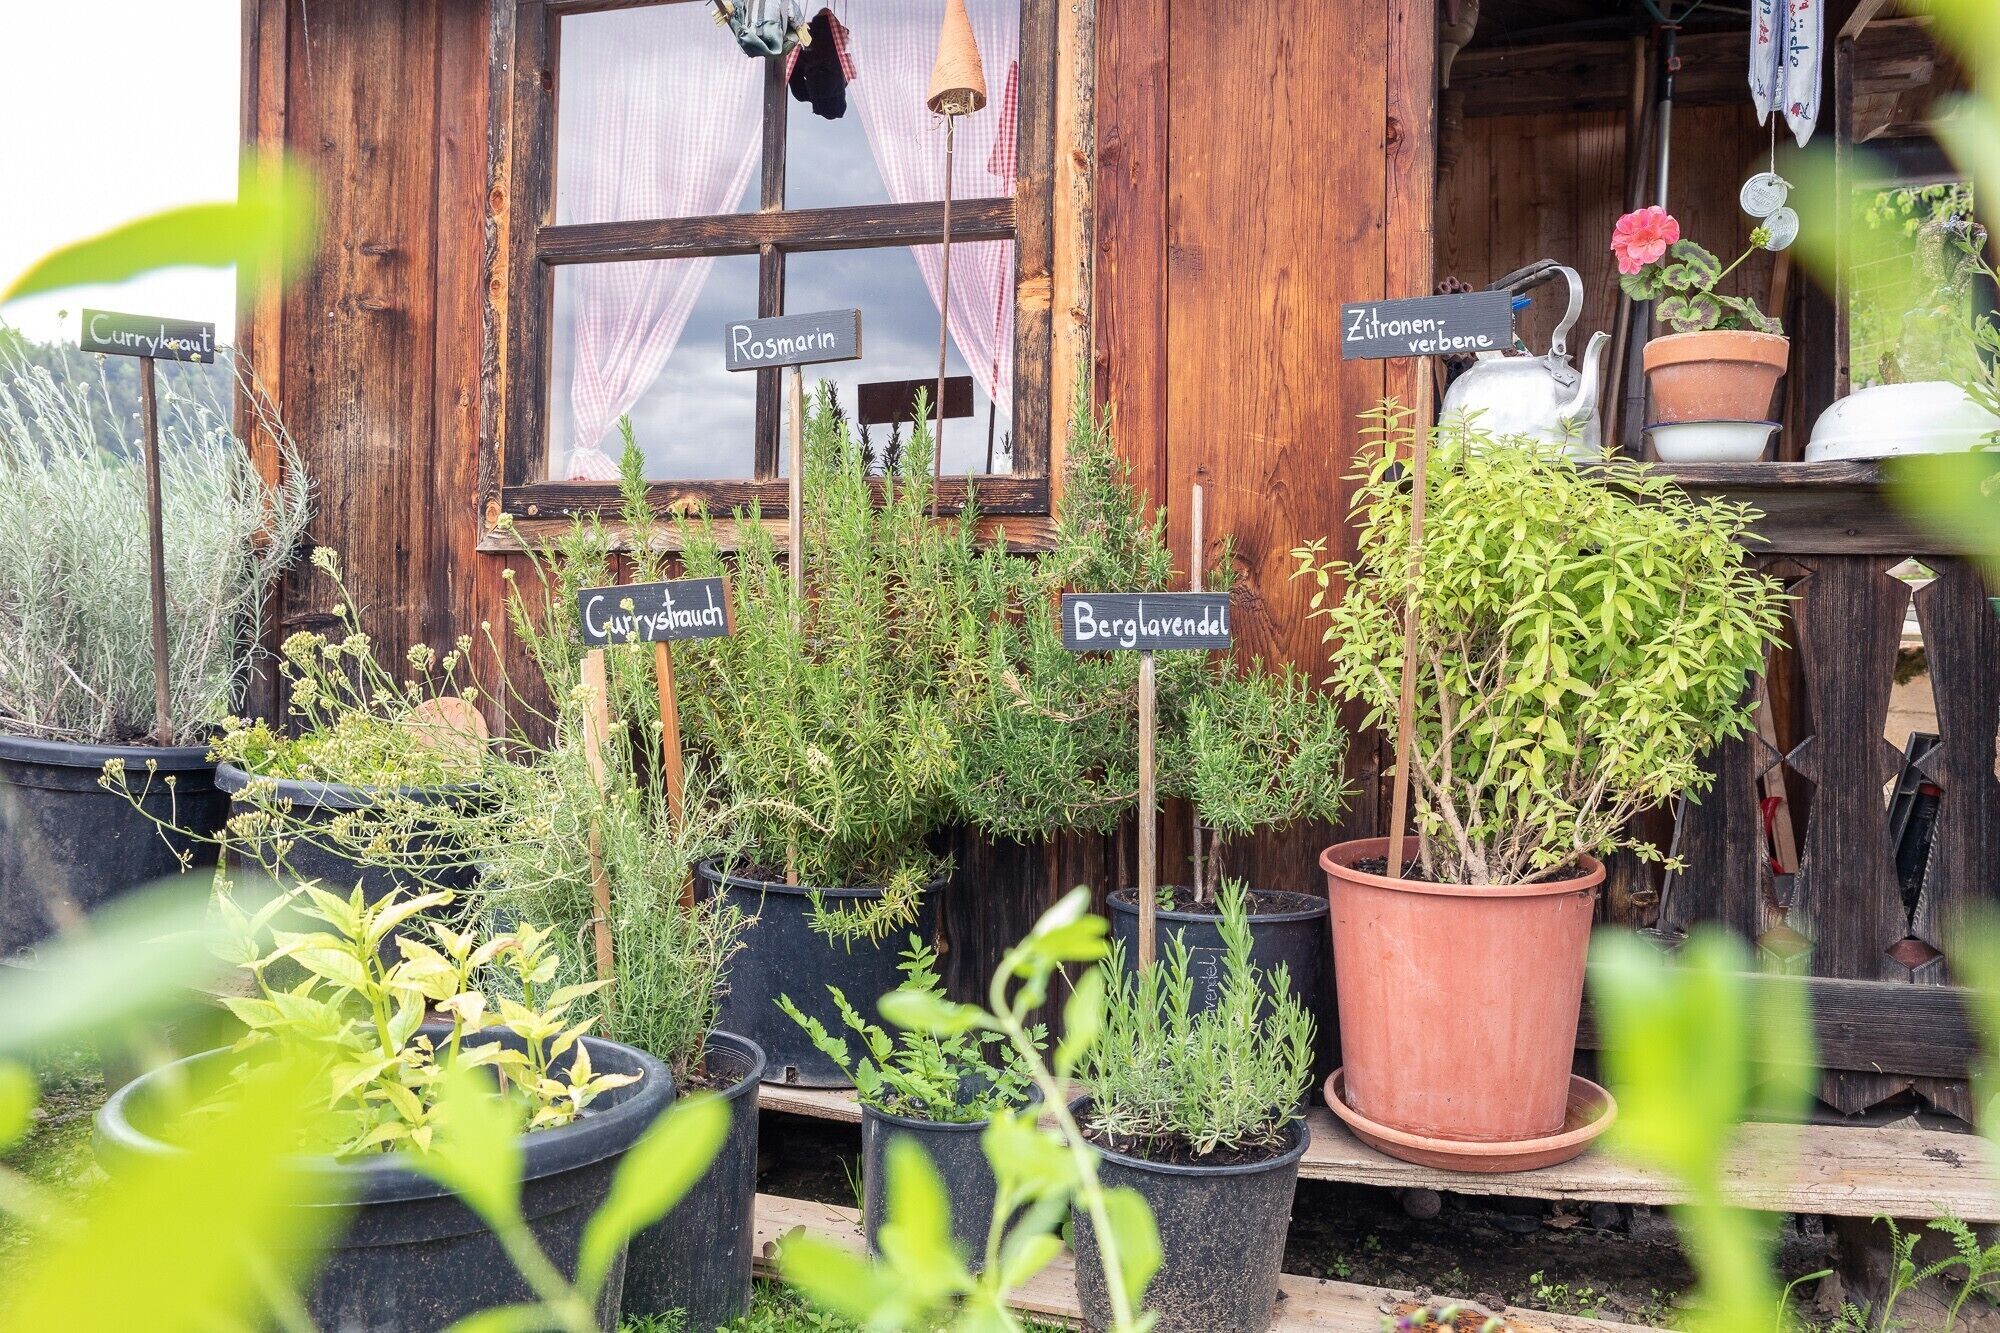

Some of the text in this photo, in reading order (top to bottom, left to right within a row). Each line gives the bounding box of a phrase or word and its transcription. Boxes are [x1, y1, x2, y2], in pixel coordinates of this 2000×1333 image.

[732, 324, 836, 362] Rosmarin
[1346, 308, 1446, 342] Zitronen-
[1408, 329, 1494, 353] verbene
[585, 585, 724, 641] Currystrauch
[1073, 598, 1229, 648] Berglavendel
